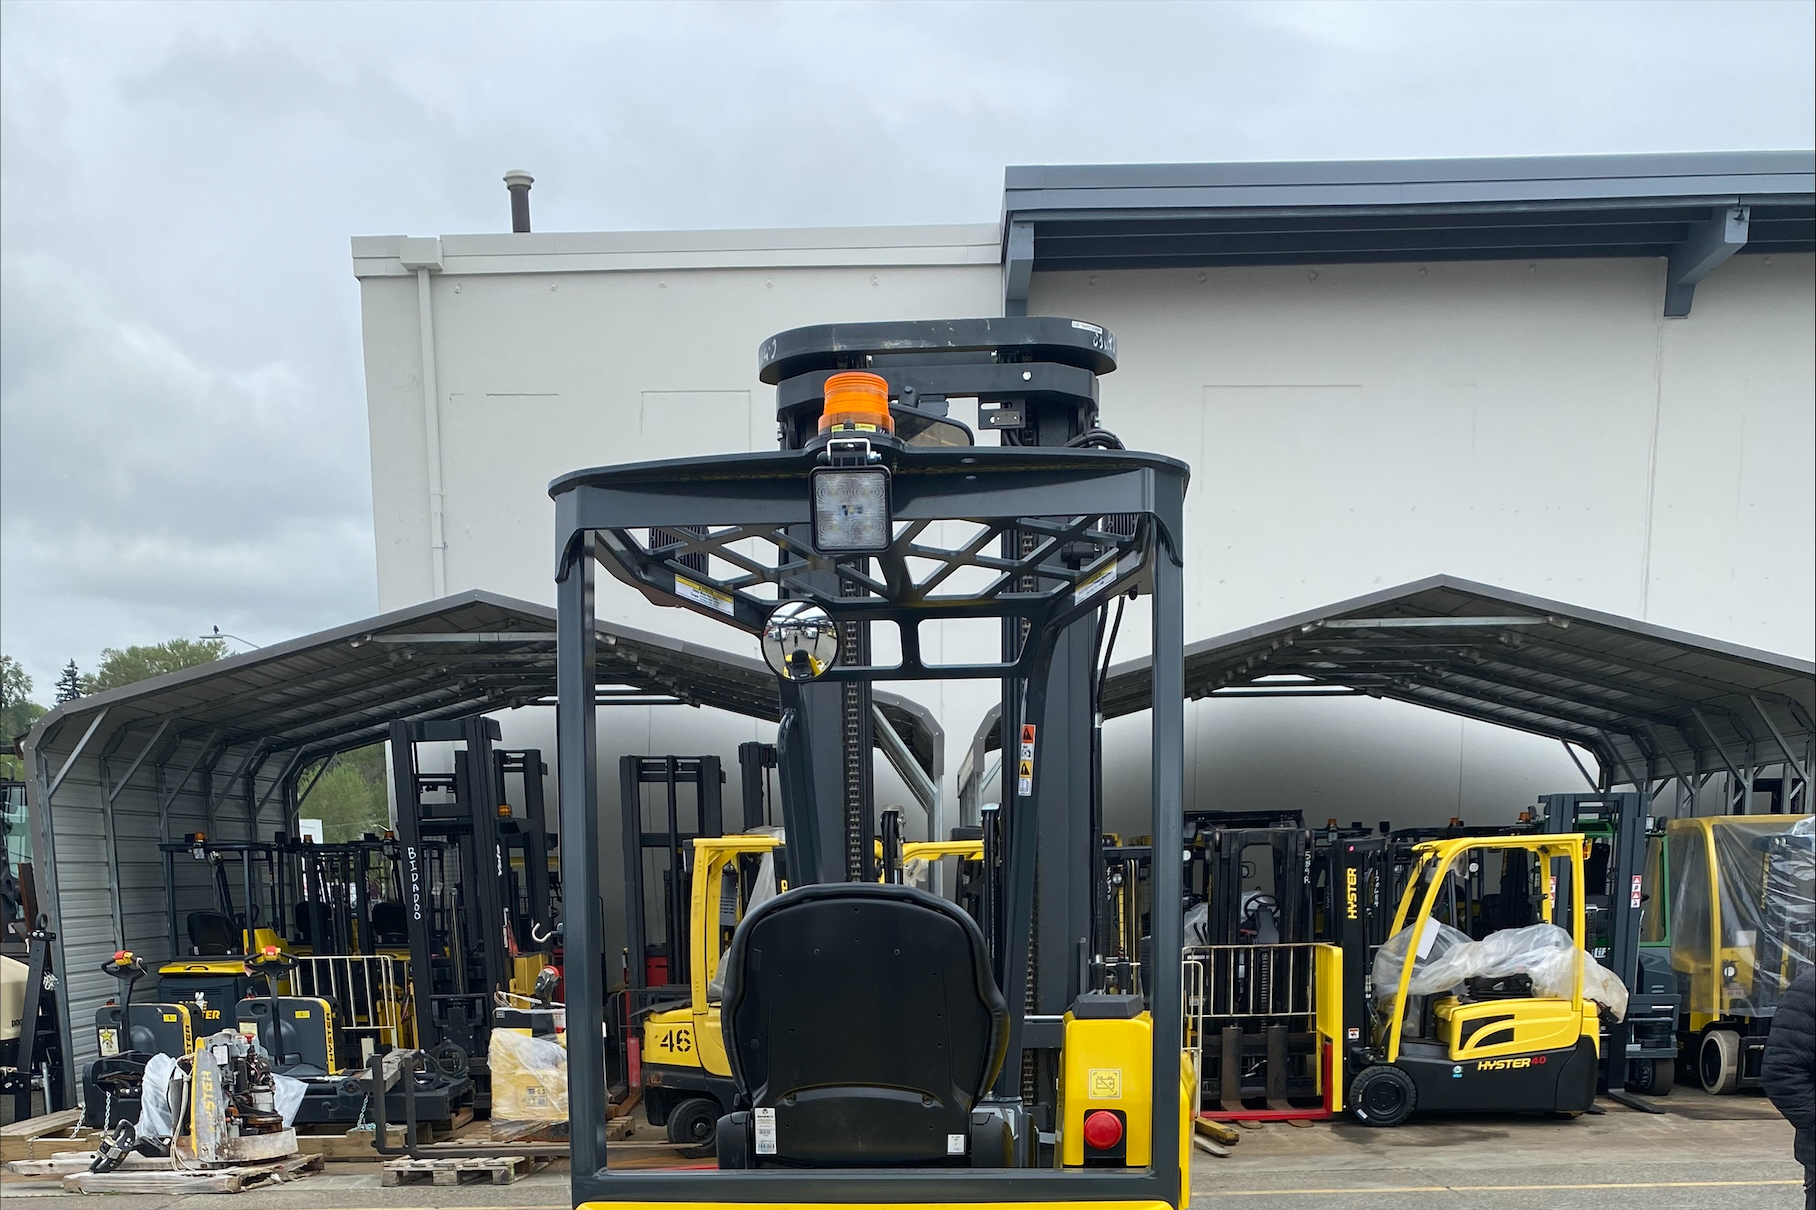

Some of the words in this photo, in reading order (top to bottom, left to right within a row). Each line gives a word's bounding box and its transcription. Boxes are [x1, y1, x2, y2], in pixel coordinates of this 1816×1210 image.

[407, 846, 422, 920] BIDADOO
[1346, 867, 1358, 919] HYSTER
[184, 1025, 193, 1054] STER
[325, 1012, 335, 1062] HYSTER
[660, 1029, 691, 1053] 46
[1477, 1058, 1531, 1071] HYSTER
[1531, 1056, 1547, 1065] 40
